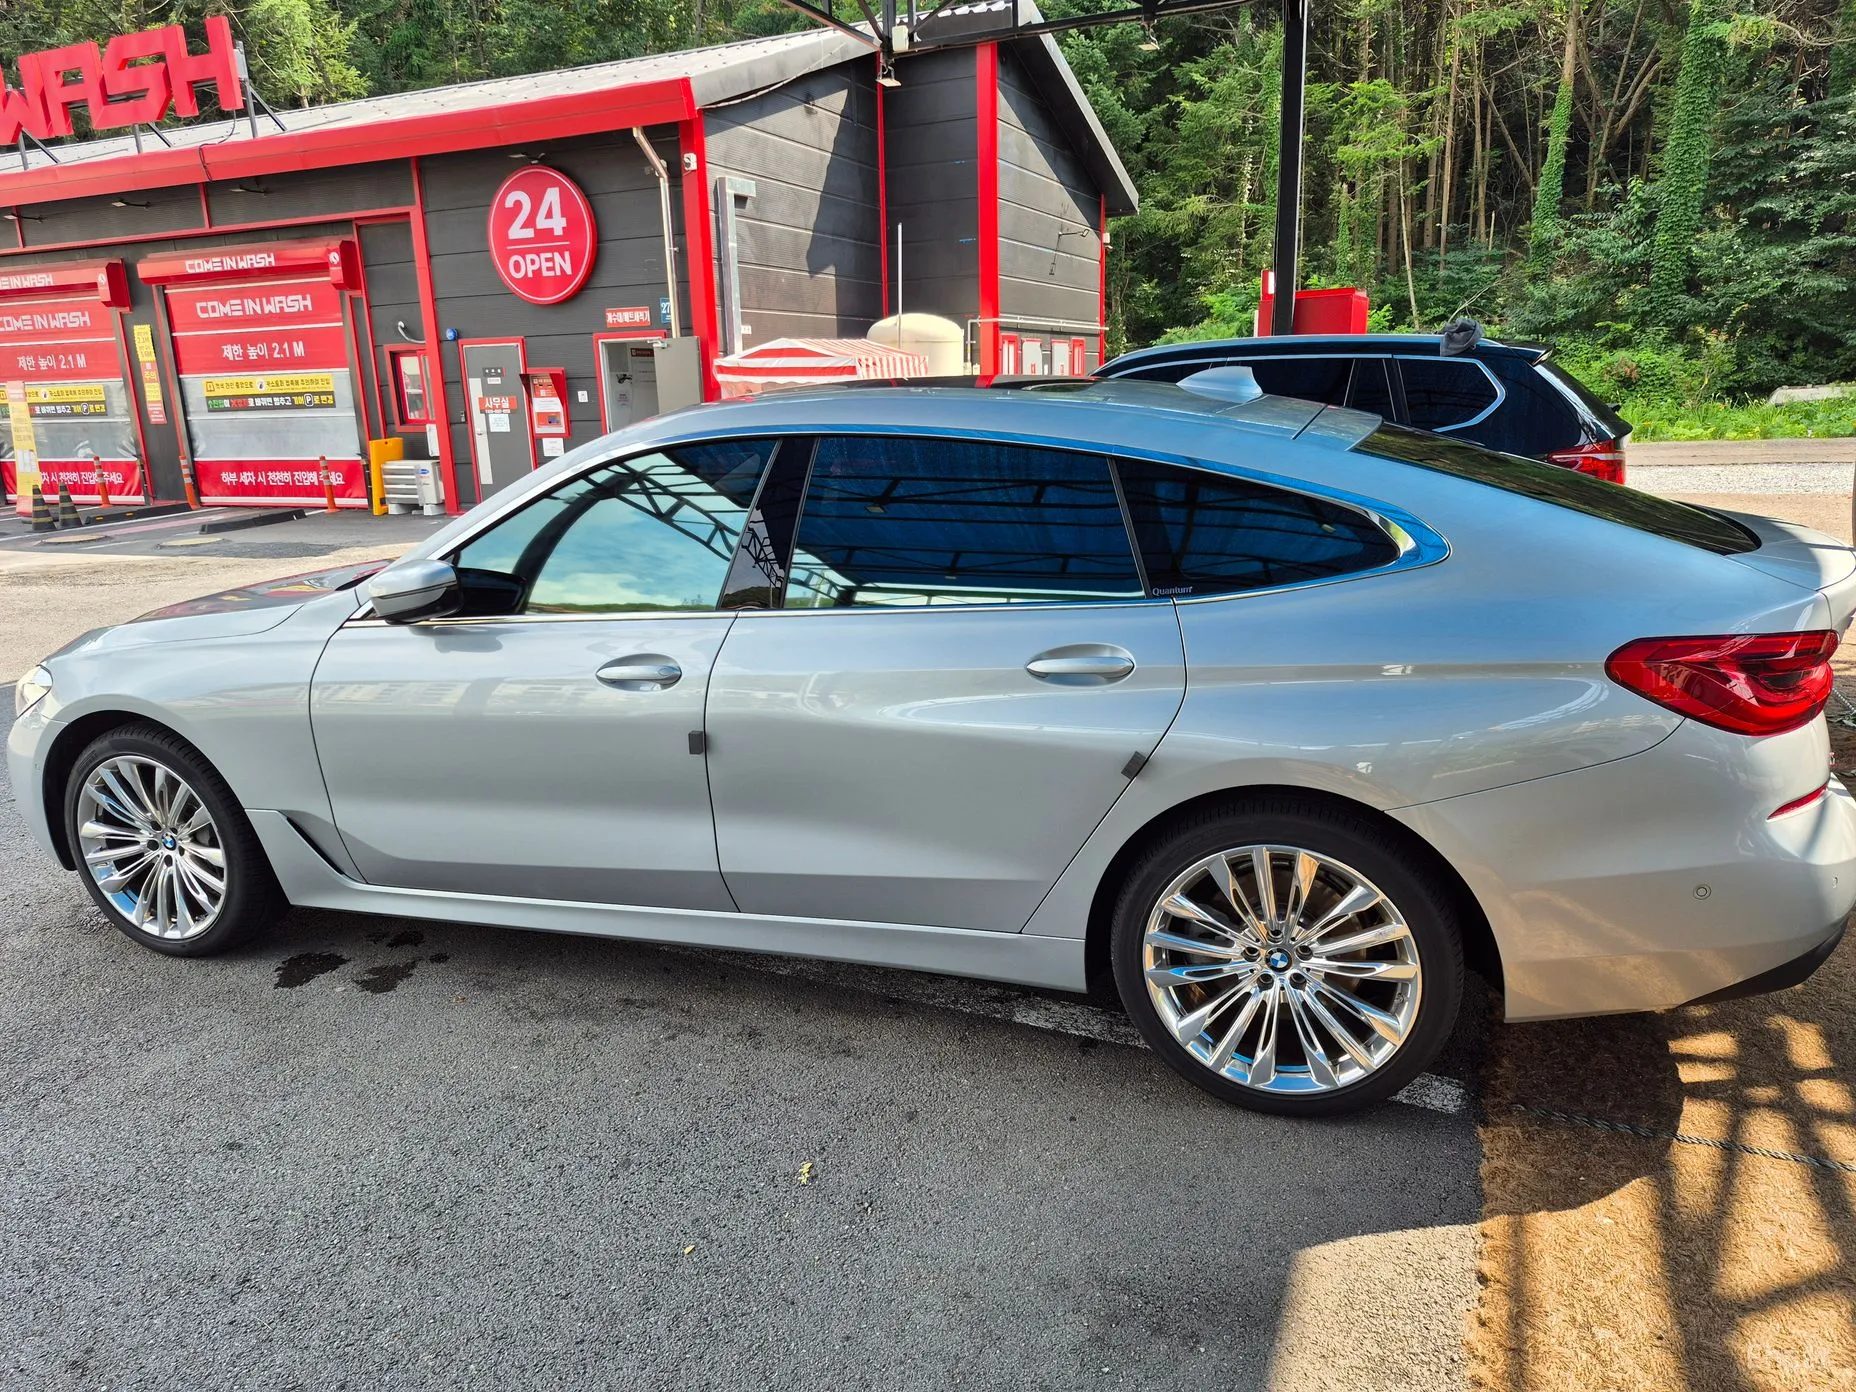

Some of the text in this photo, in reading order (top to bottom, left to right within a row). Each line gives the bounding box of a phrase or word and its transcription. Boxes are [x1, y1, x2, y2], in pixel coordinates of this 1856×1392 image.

[0, 15, 244, 146] WASH
[504, 186, 567, 240] 24
[185, 253, 276, 273] COME IN WASH
[508, 251, 572, 279] OPEN
[21, 273, 54, 288] WASH
[195, 294, 313, 318] COME IN WASH
[33, 314, 49, 330] IN
[48, 311, 91, 329] WASH
[221, 341, 305, 361] 제한 높이 2.1 M
[16, 353, 87, 371] 제한 높이 2.1 M
[484, 396, 510, 409] 사무실
[80, 471, 98, 485] 진입
[257, 471, 267, 485] 시
[267, 471, 292, 486] 천천히
[293, 471, 319, 486] 진입해
